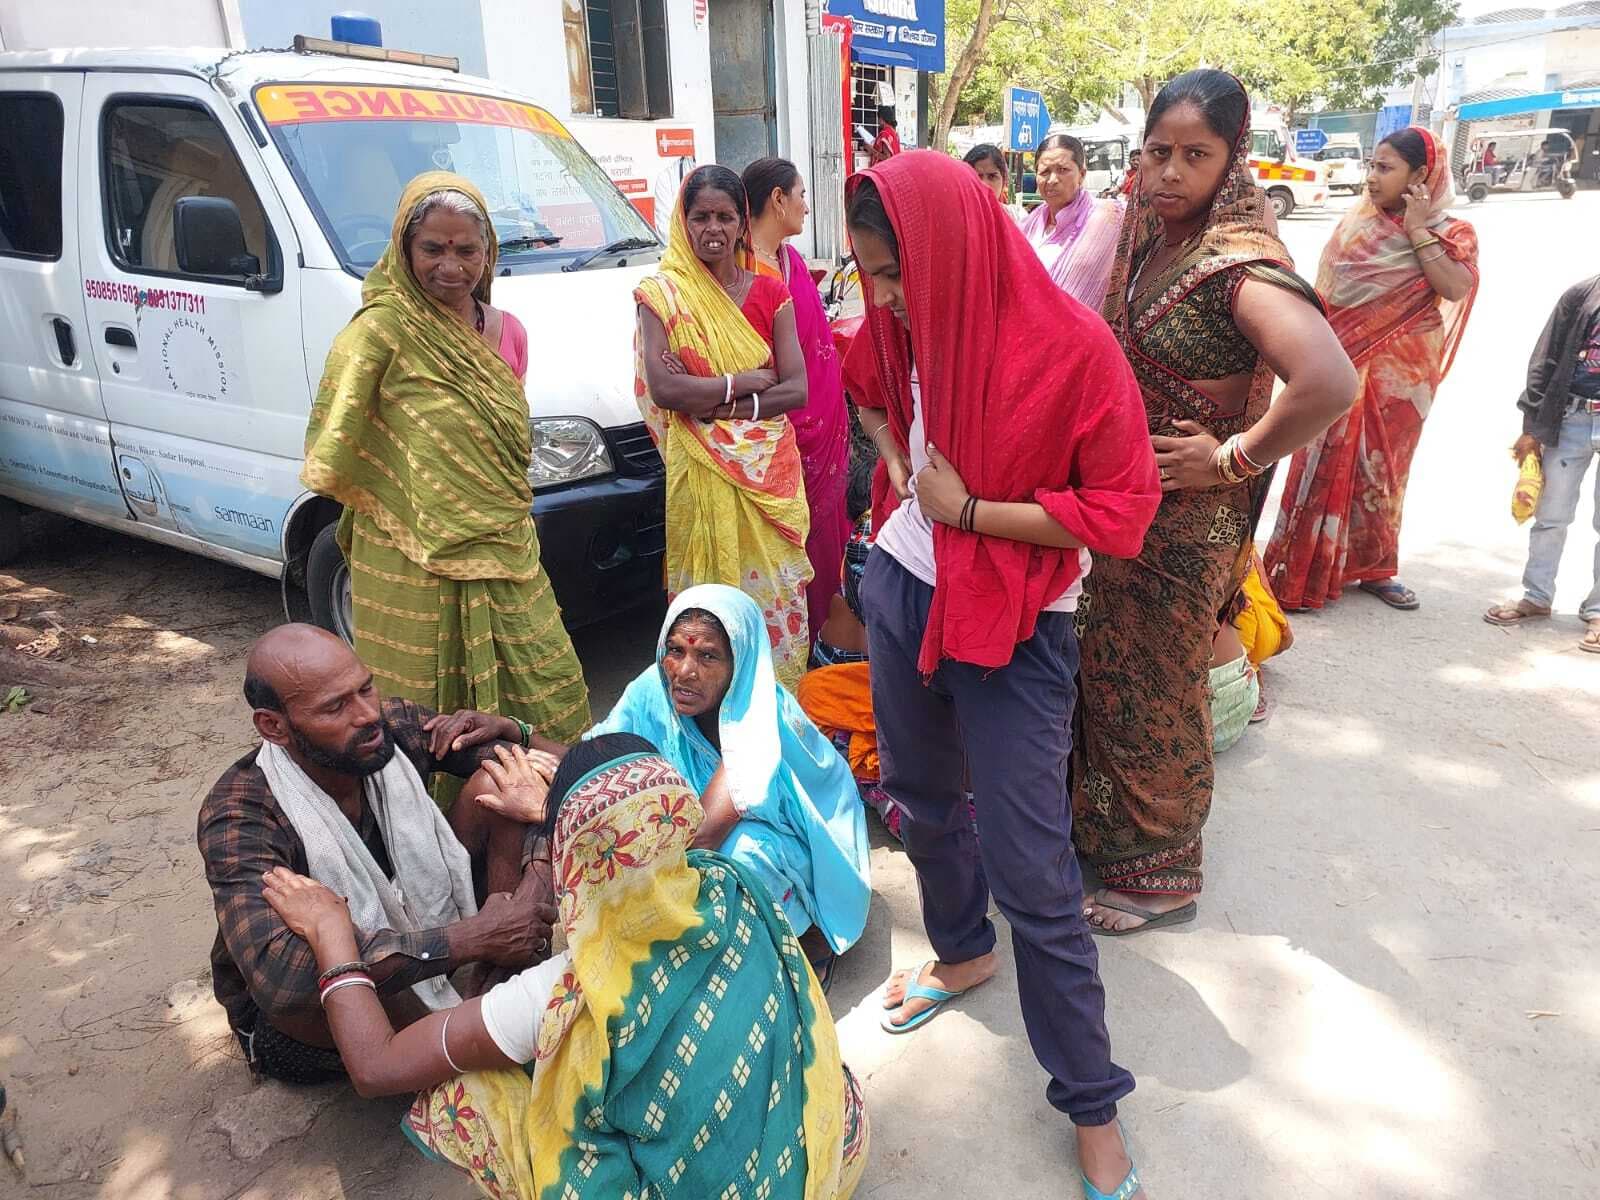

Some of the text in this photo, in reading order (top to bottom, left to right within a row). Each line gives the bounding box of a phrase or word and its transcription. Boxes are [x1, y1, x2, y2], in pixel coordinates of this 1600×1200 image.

[886, 25, 897, 43] 7
[161, 317, 227, 395] NATIONAL HEALTH MISSION
[214, 505, 275, 533] sammaan
